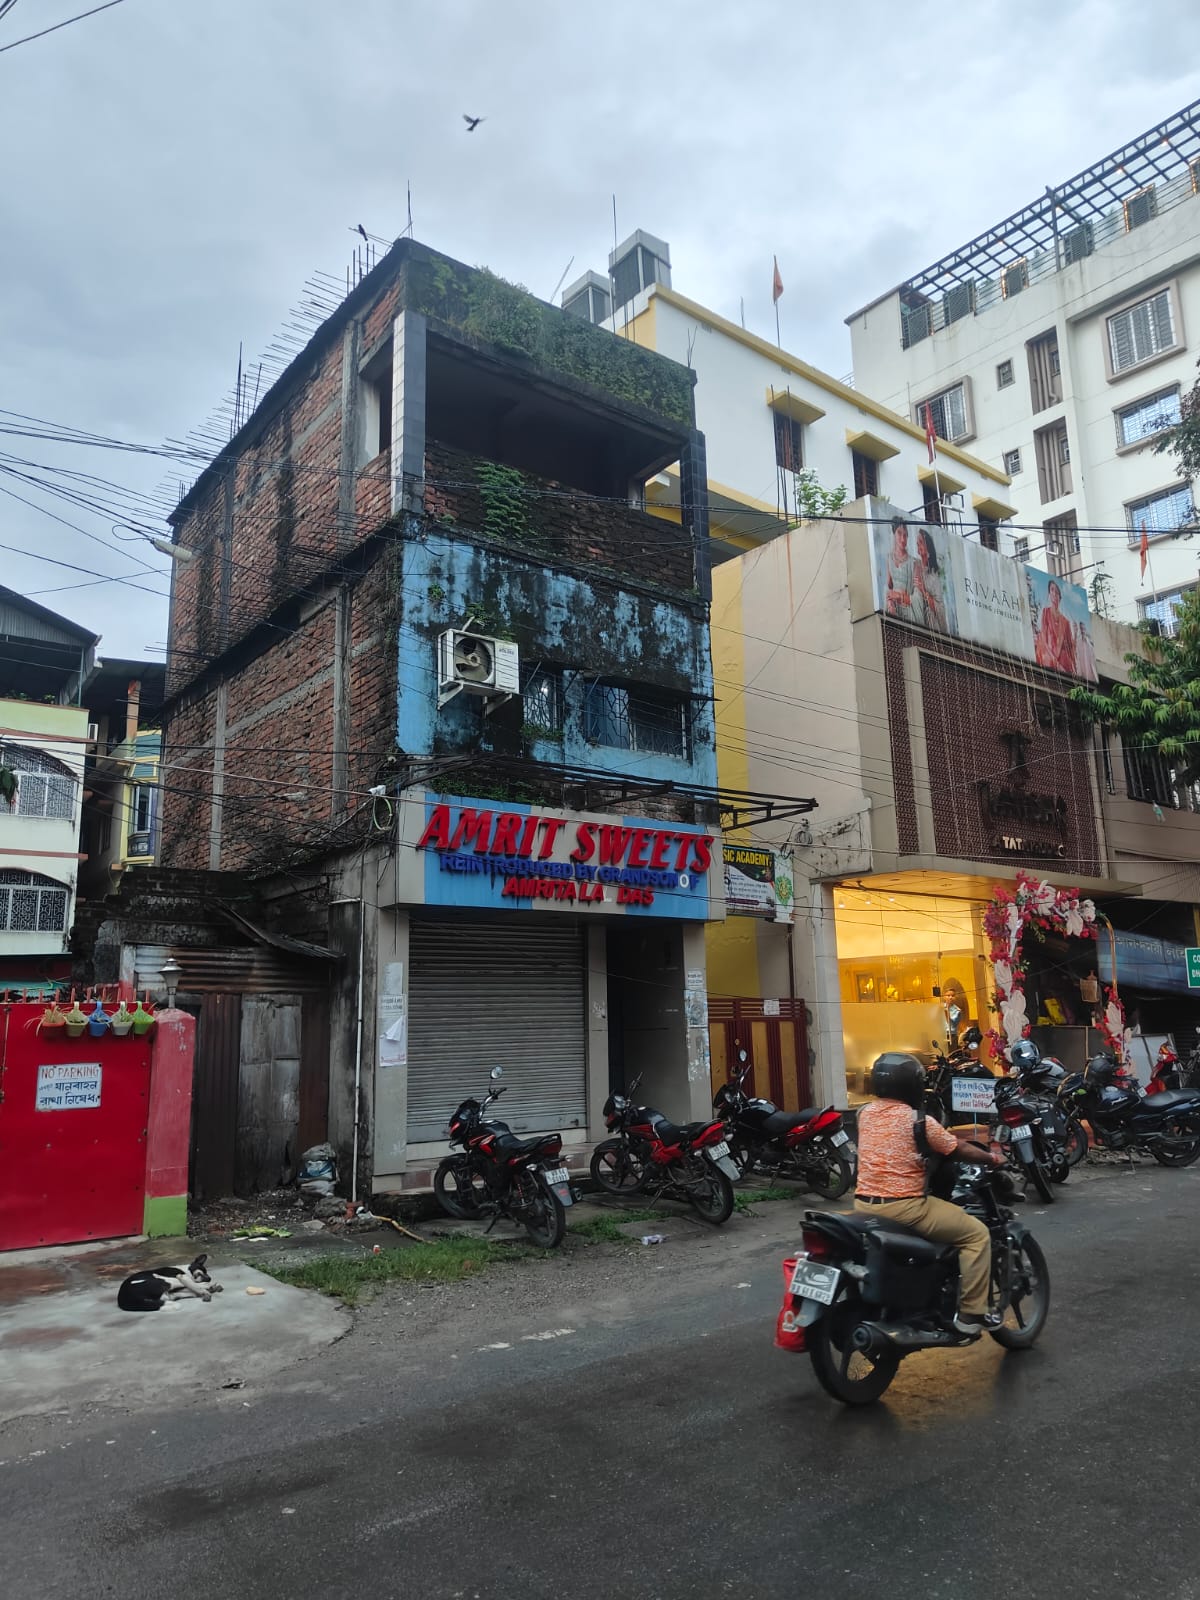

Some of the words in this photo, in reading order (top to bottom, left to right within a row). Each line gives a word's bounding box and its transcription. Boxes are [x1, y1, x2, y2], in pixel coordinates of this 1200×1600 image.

[416, 804, 567, 860] AMRIT
[570, 821, 714, 873] SWEETS
[439, 853, 573, 880] REINTRODUCED
[575, 862, 598, 882] BY
[598, 868, 679, 889] GRANDSON
[679, 872, 700, 891] OF
[616, 886, 655, 906] DAS
[42, 1067, 55, 1079] NO
[58, 1066, 99, 1079] PARKING
[55, 1080, 98, 1093] যানবাহন
